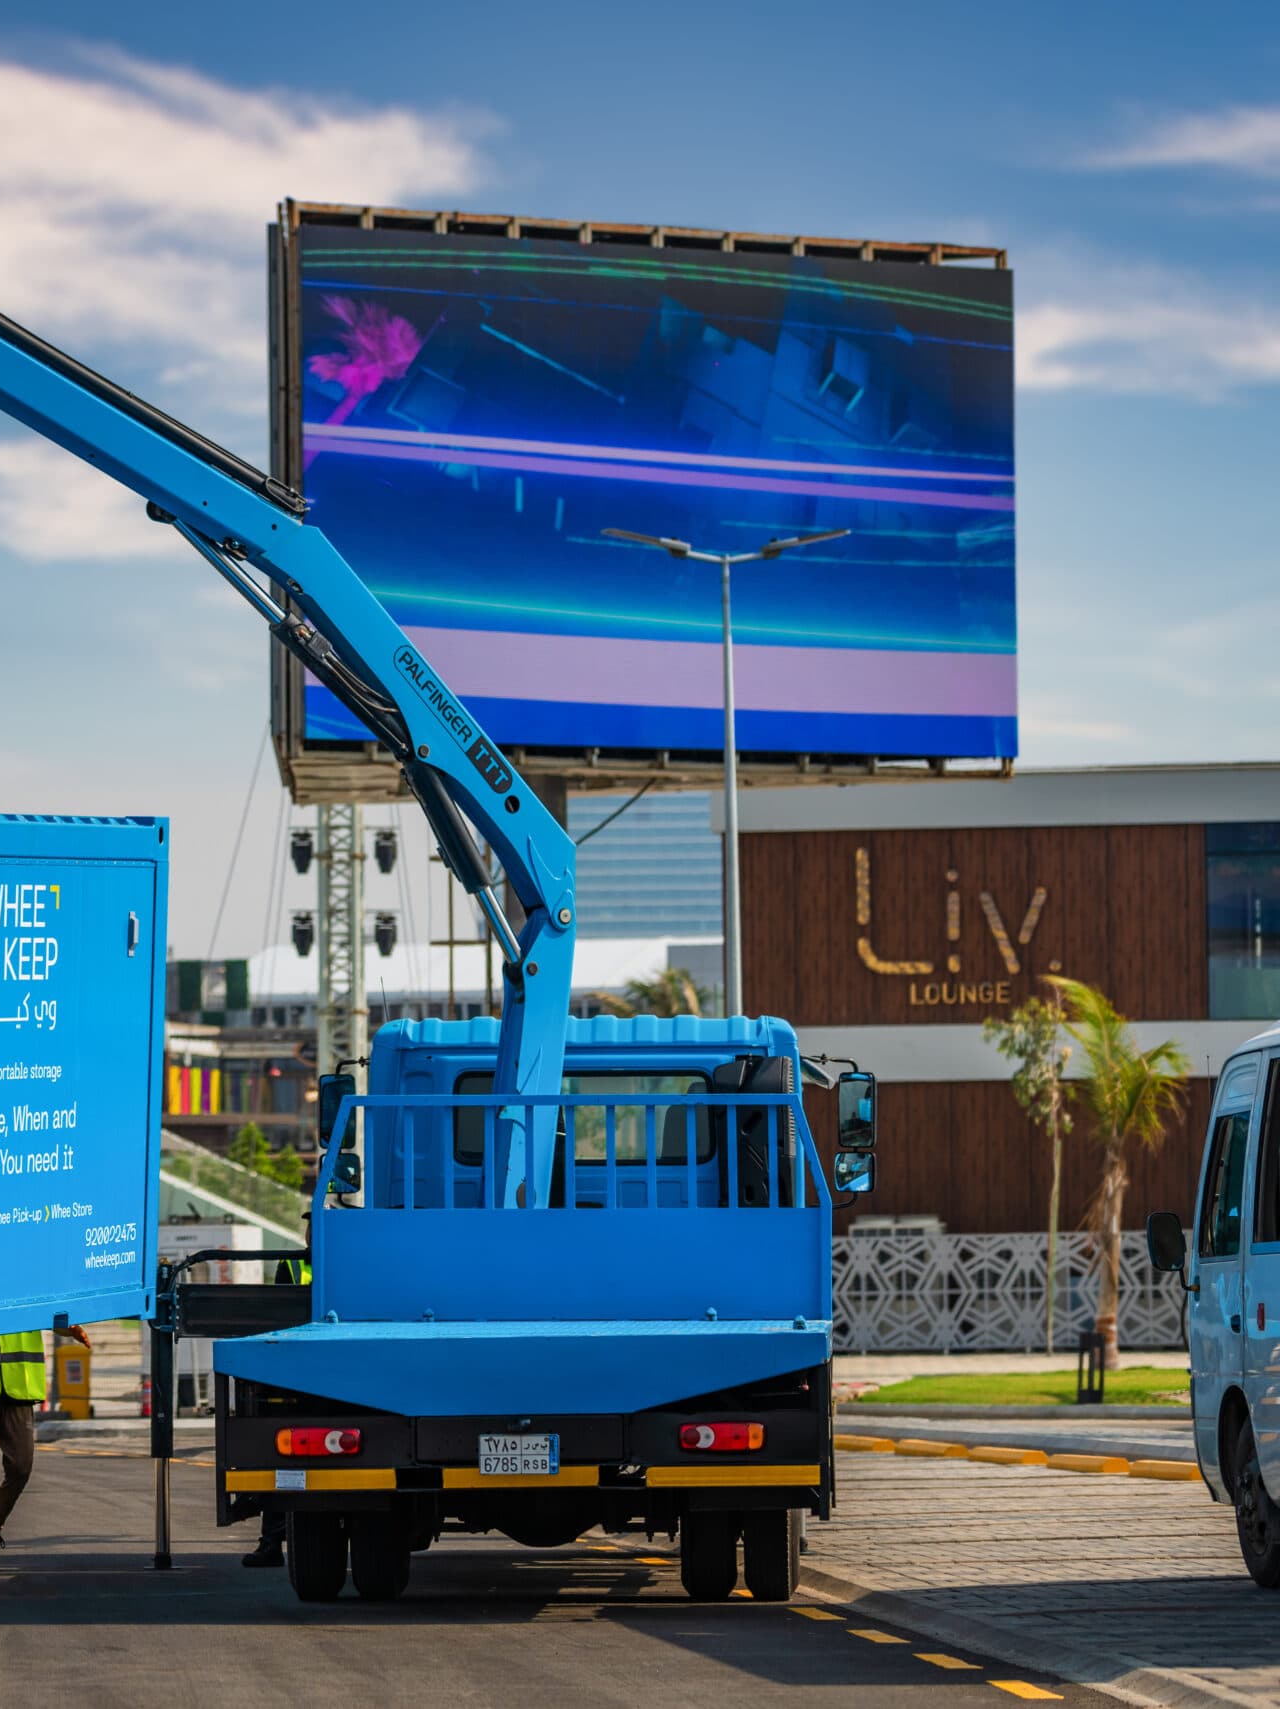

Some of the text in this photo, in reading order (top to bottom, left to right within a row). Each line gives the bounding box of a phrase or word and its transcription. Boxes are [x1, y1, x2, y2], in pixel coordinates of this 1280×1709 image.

[398, 651, 509, 786] PALFINGER TTT
[3, 937, 59, 981] KEEP
[909, 981, 1012, 1006] LOUNGE
[30, 1064, 62, 1082] storage
[13, 1104, 49, 1132] When
[52, 1101, 77, 1129] and
[0, 1148, 23, 1175] You
[26, 1143, 59, 1173] need
[62, 1143, 74, 1170] it
[12, 1207, 43, 1224] Pick-up
[51, 1201, 93, 1220] Whee Store
[85, 1222, 137, 1247] 920022475
[84, 1249, 136, 1270] wheekeep.com
[484, 1457, 518, 1473] 6785
